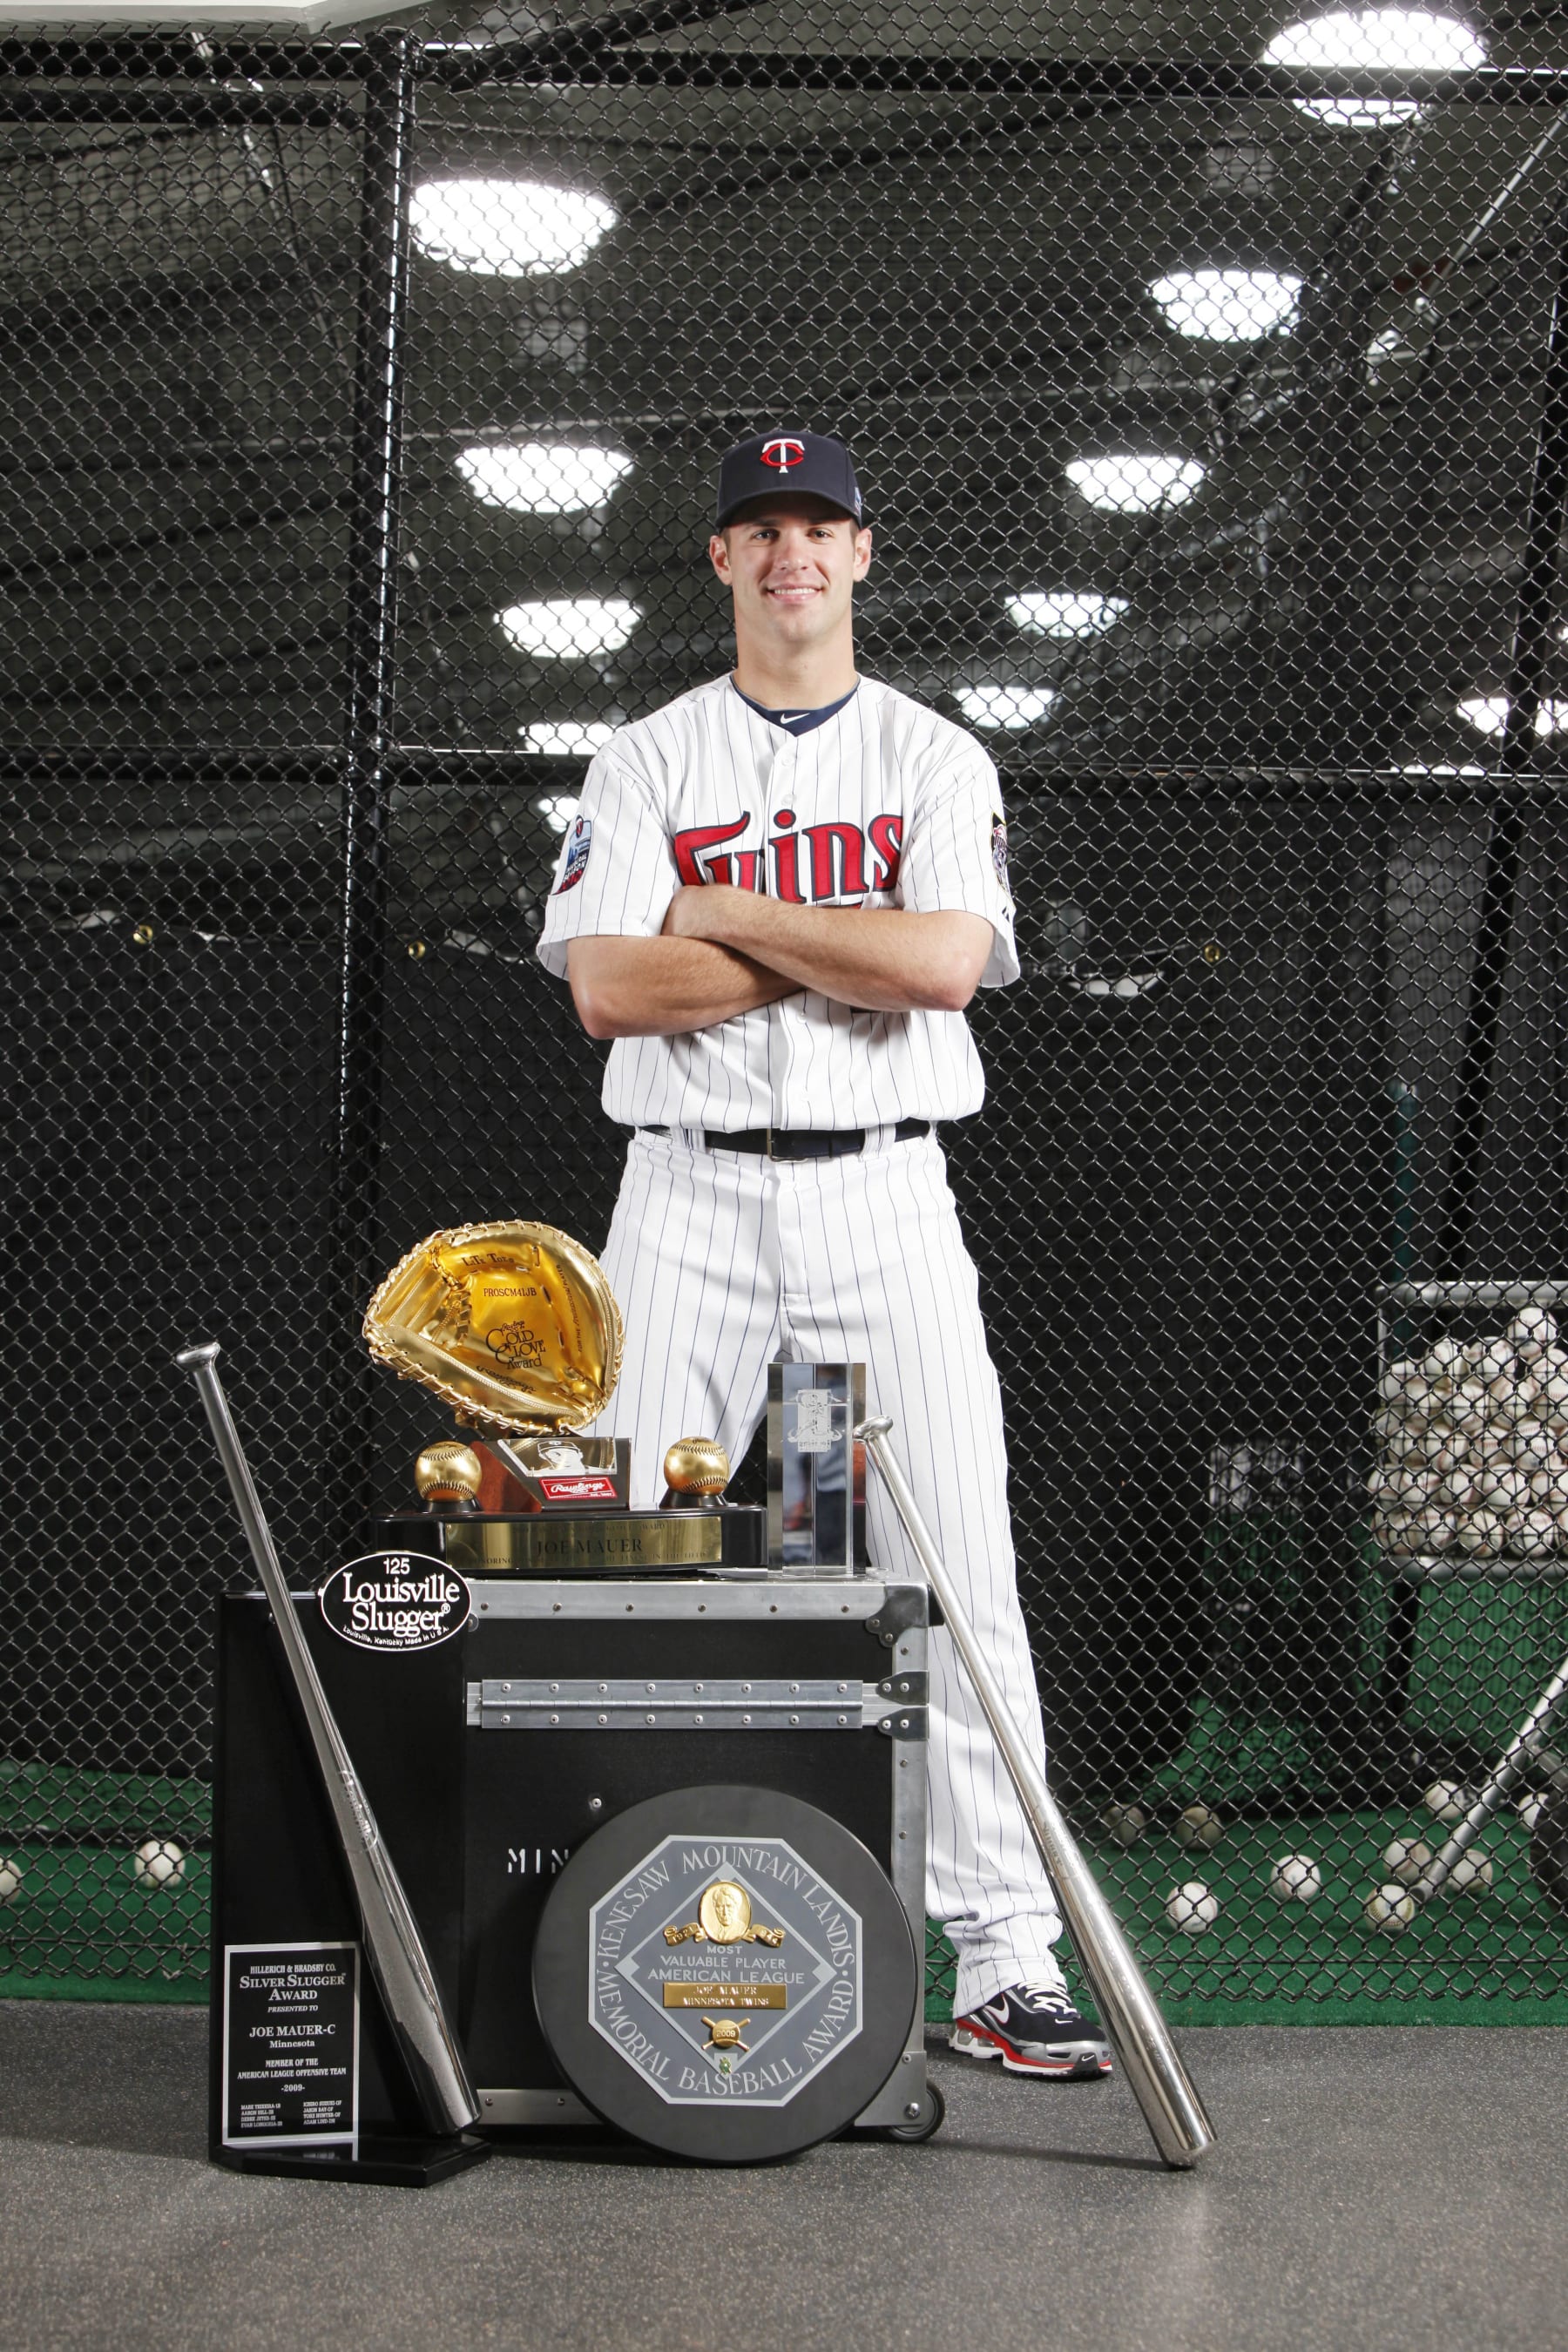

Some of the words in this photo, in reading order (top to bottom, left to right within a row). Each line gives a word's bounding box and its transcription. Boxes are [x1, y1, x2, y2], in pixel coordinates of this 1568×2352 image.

[506, 1354, 543, 1369] Award
[551, 1482, 605, 1494] Rawlings
[537, 1539, 570, 1556] JOE
[576, 1538, 642, 1554] MAUER
[383, 1558, 410, 1574] 125
[342, 1572, 460, 1603] Louisville
[374, 1637, 404, 1646] Kentucky
[405, 1636, 422, 1645] Made
[597, 1860, 670, 1959] KENESAW
[683, 1845, 808, 1890] MOUNTAIN
[802, 1882, 855, 1968] LANDIS
[706, 1945, 743, 1955] MOST
[250, 1964, 286, 1975] HILLERICH
[287, 1964, 294, 1973] &
[294, 1963, 325, 1973] BRADSBY
[660, 1955, 728, 1968] VALUABLE
[735, 1957, 787, 1970] PLAYER
[240, 1976, 285, 1989] SILVER
[647, 1969, 731, 1982] AMERICAN
[740, 1971, 805, 1984] LEAGUE
[268, 1988, 318, 2001] AWARD
[694, 1986, 713, 1995] JOE
[720, 1986, 757, 1995] MAUER
[682, 1997, 735, 2006] MINNESOTA
[249, 2026, 274, 2038] JOE
[276, 2024, 336, 2037] MAUER-C
[597, 1969, 671, 2080] MEMORIAL
[677, 2057, 802, 2096] BASEBALL
[801, 1980, 854, 2063] AWARD
[716, 2029, 736, 2038] 2009
[269, 2040, 315, 2049] Minnesota
[265, 2058, 294, 2068] MEMBER
[305, 2058, 319, 2066] THE
[237, 2071, 270, 2080] AMERICAN
[270, 2069, 294, 2078] LEAGUE
[295, 2068, 329, 2077] OFFENSIVE
[329, 2067, 347, 2076] TEAM
